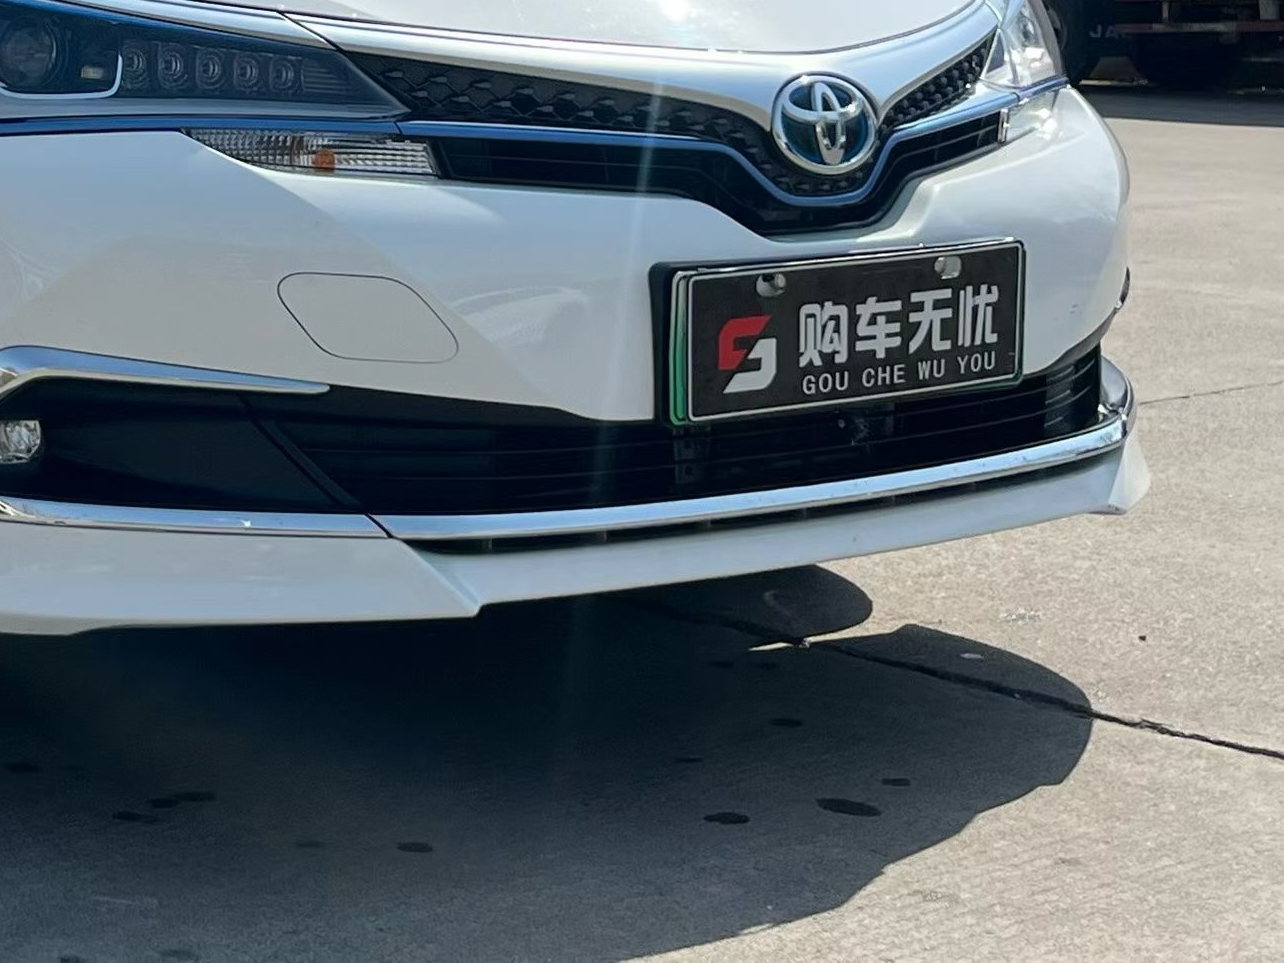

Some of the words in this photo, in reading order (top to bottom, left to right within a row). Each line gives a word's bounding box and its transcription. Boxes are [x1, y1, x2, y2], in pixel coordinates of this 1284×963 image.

[798, 283, 1000, 368] 购车无忧
[802, 371, 849, 395] GOU
[862, 364, 906, 388] CHE
[918, 358, 946, 381] WU
[957, 350, 997, 374] YOU
